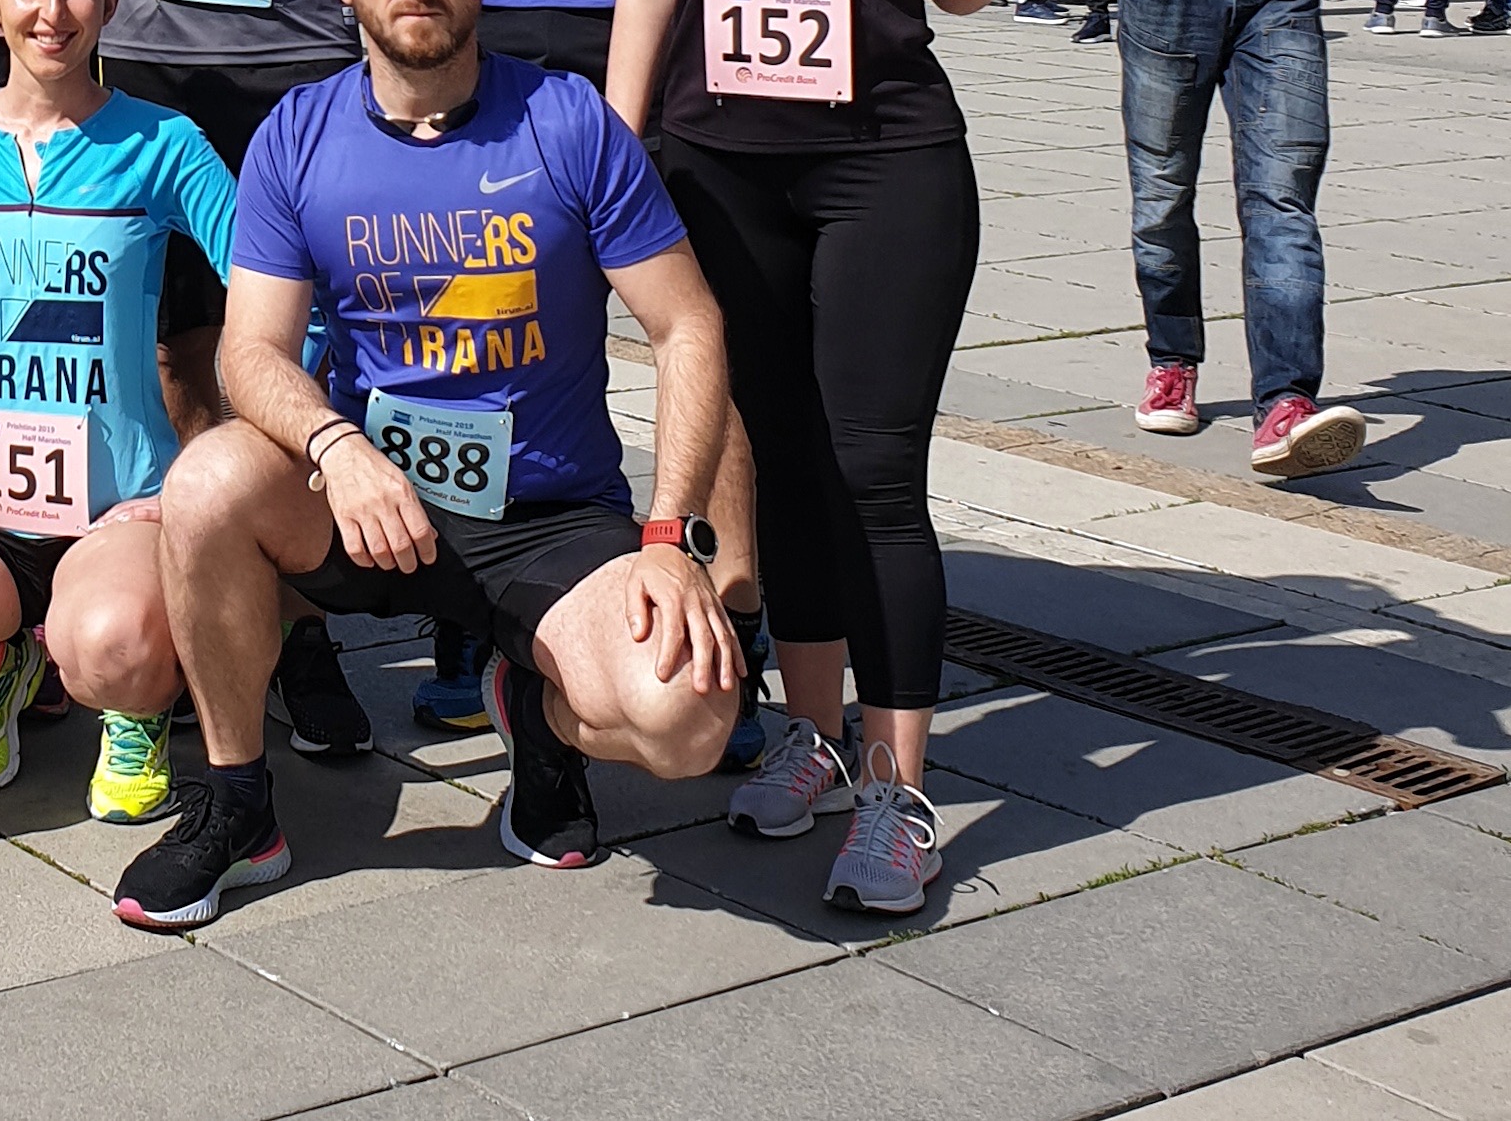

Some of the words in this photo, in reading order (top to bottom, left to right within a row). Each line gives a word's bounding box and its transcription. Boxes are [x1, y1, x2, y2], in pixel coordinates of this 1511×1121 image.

[722, 6, 832, 68] 152
[757, 73, 794, 84] ProCredit
[796, 75, 817, 85] Bank
[346, 209, 537, 268] RUNNERS
[356, 271, 403, 315] OF
[366, 318, 546, 374] TIRANA
[6, 422, 36, 432] Prishtina
[38, 425, 55, 434] 2019
[38, 435, 71, 445] Marathon
[381, 426, 490, 492] 888
[6, 506, 40, 518] ProCredit
[41, 511, 60, 520] Bank
[450, 494, 471, 505] Bank
